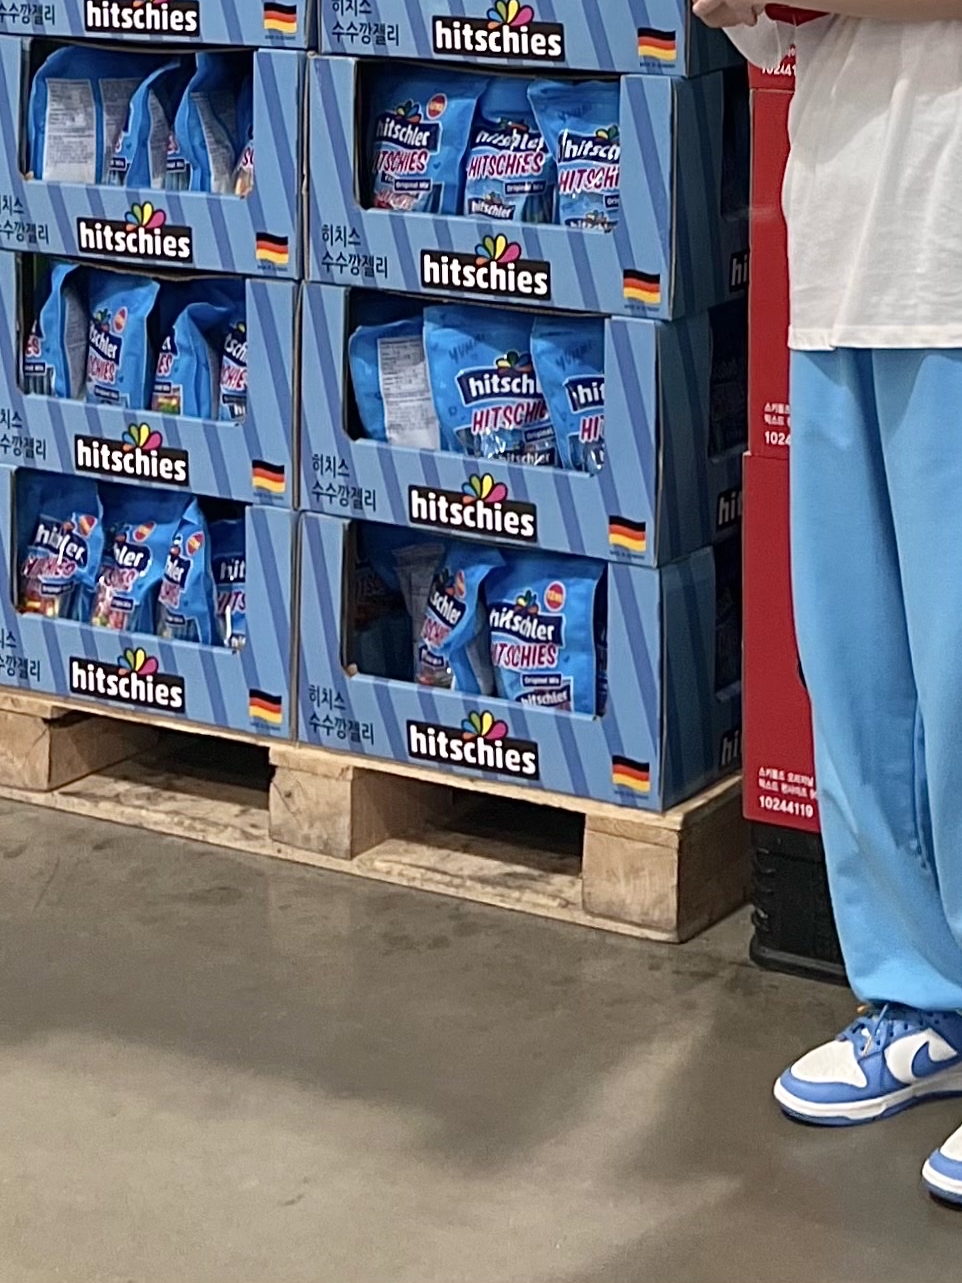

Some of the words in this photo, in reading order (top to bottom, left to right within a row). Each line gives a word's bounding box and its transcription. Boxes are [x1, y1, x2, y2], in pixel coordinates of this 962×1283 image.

[87, 1, 198, 32] hitschies
[332, 23, 400, 47] 수수깡젤리
[436, 21, 562, 57] hitschies
[468, 151, 545, 178] HITSCHIES
[79, 221, 190, 258] hitschies
[321, 224, 361, 247] 히치스
[321, 253, 388, 278] 수수깡젤리
[423, 254, 548, 296] hitschies
[76, 439, 187, 481] hitschies
[312, 453, 349, 480] 히치스
[312, 483, 377, 513] 수수깡젤리
[410, 490, 535, 538] hitschies
[72, 661, 183, 708] hitschies
[308, 685, 346, 711] 히치스
[308, 714, 374, 745] 수수깡젤리
[410, 728, 536, 776] hitschies
[759, 795, 814, 818] 10244119
